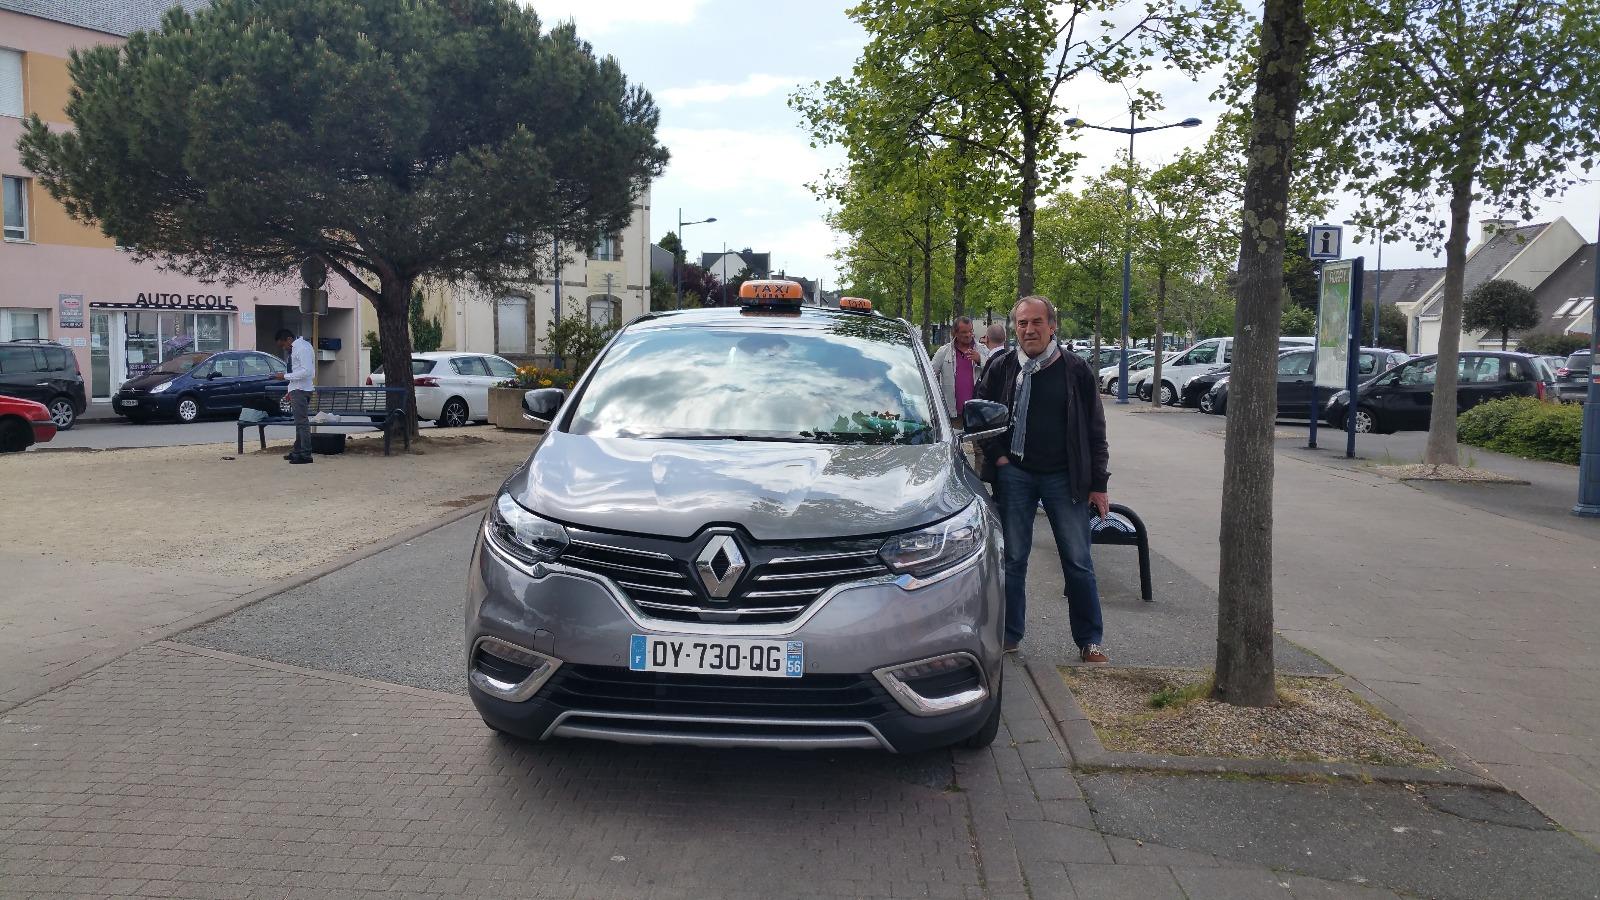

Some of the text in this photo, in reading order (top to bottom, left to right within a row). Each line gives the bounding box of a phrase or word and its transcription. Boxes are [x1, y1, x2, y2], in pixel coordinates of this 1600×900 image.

[752, 285, 789, 294] TAXI
[136, 292, 233, 308] AUTO ECOLE
[635, 656, 641, 664] F
[652, 640, 781, 672] DY-730-QG
[787, 660, 801, 673] 56
